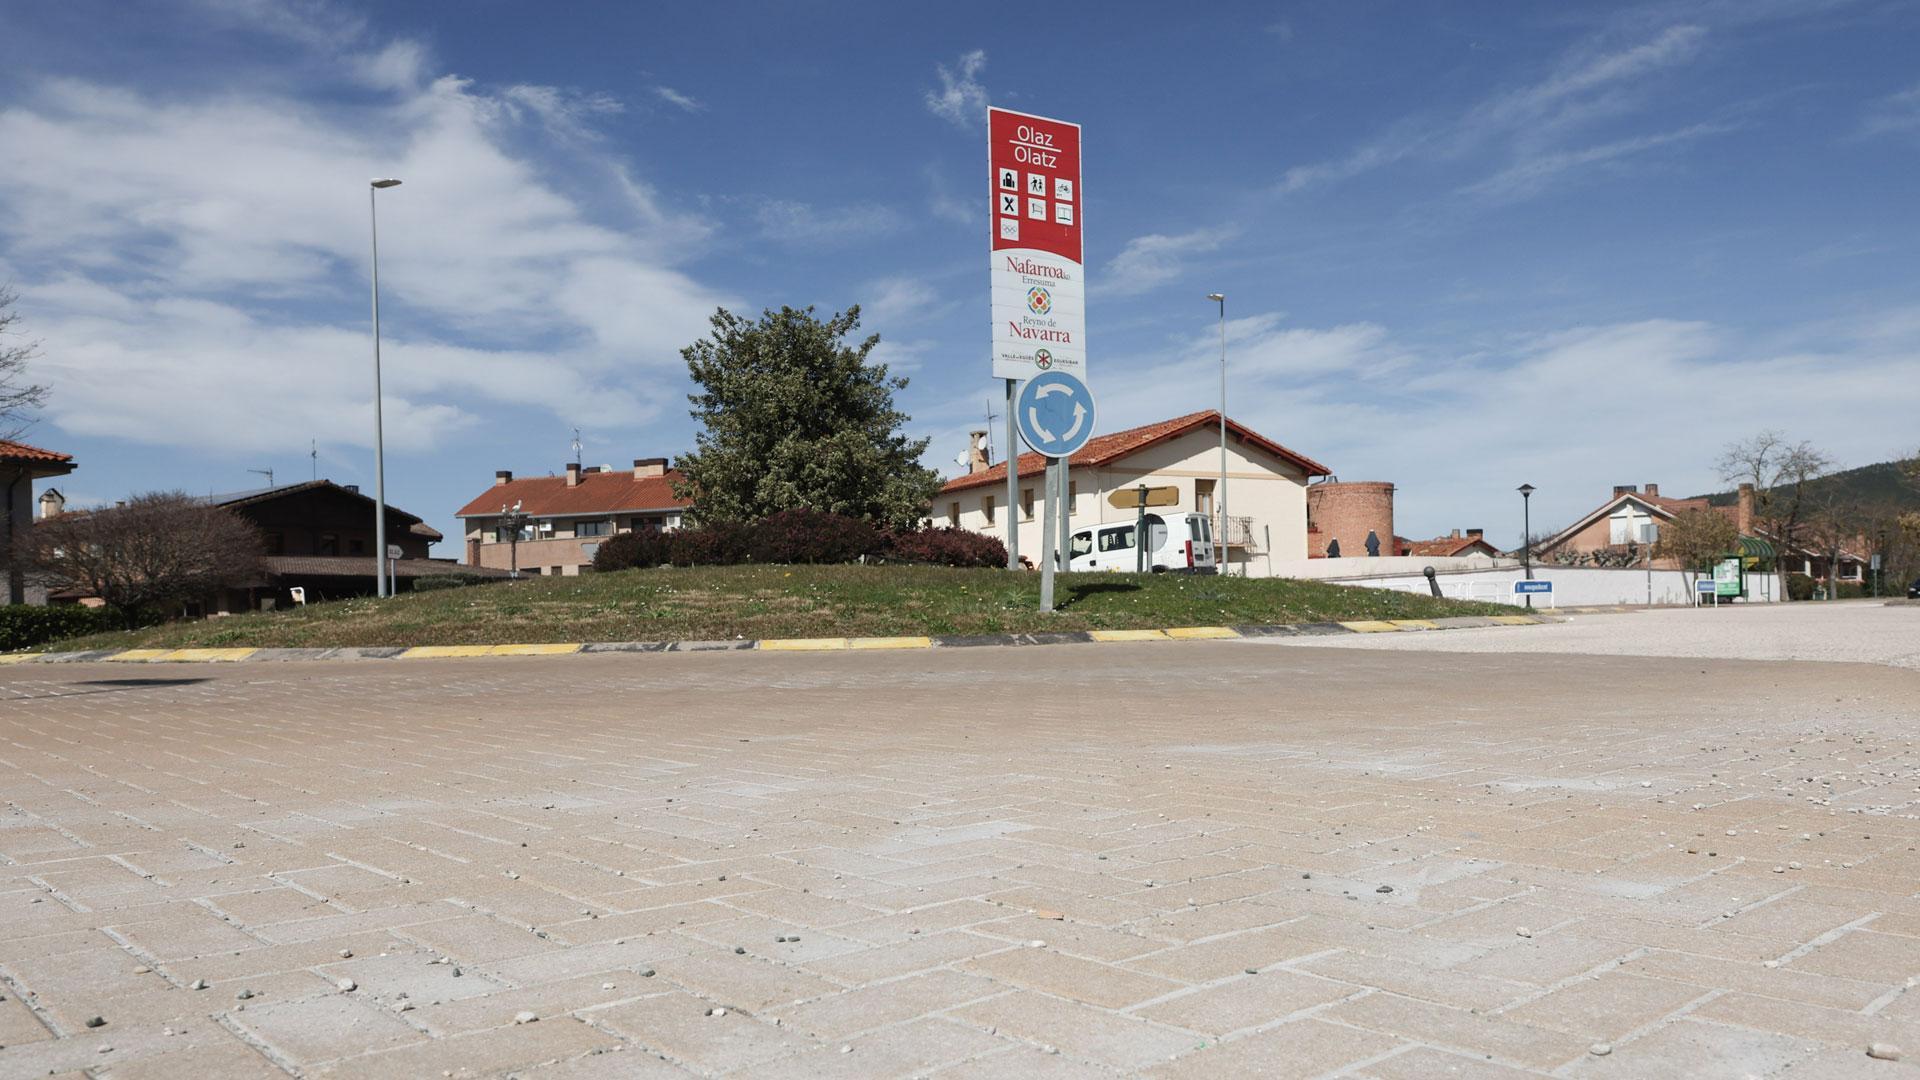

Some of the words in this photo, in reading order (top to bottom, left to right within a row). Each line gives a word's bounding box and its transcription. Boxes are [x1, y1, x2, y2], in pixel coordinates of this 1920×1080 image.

[1017, 125, 1054, 146] Olaz
[1014, 146, 1057, 168] Olatz
[1022, 275, 1056, 287] Erresuma
[1009, 321, 1071, 343] Navarra
[1023, 315, 1046, 327] Reyno
[1047, 318, 1057, 328] de
